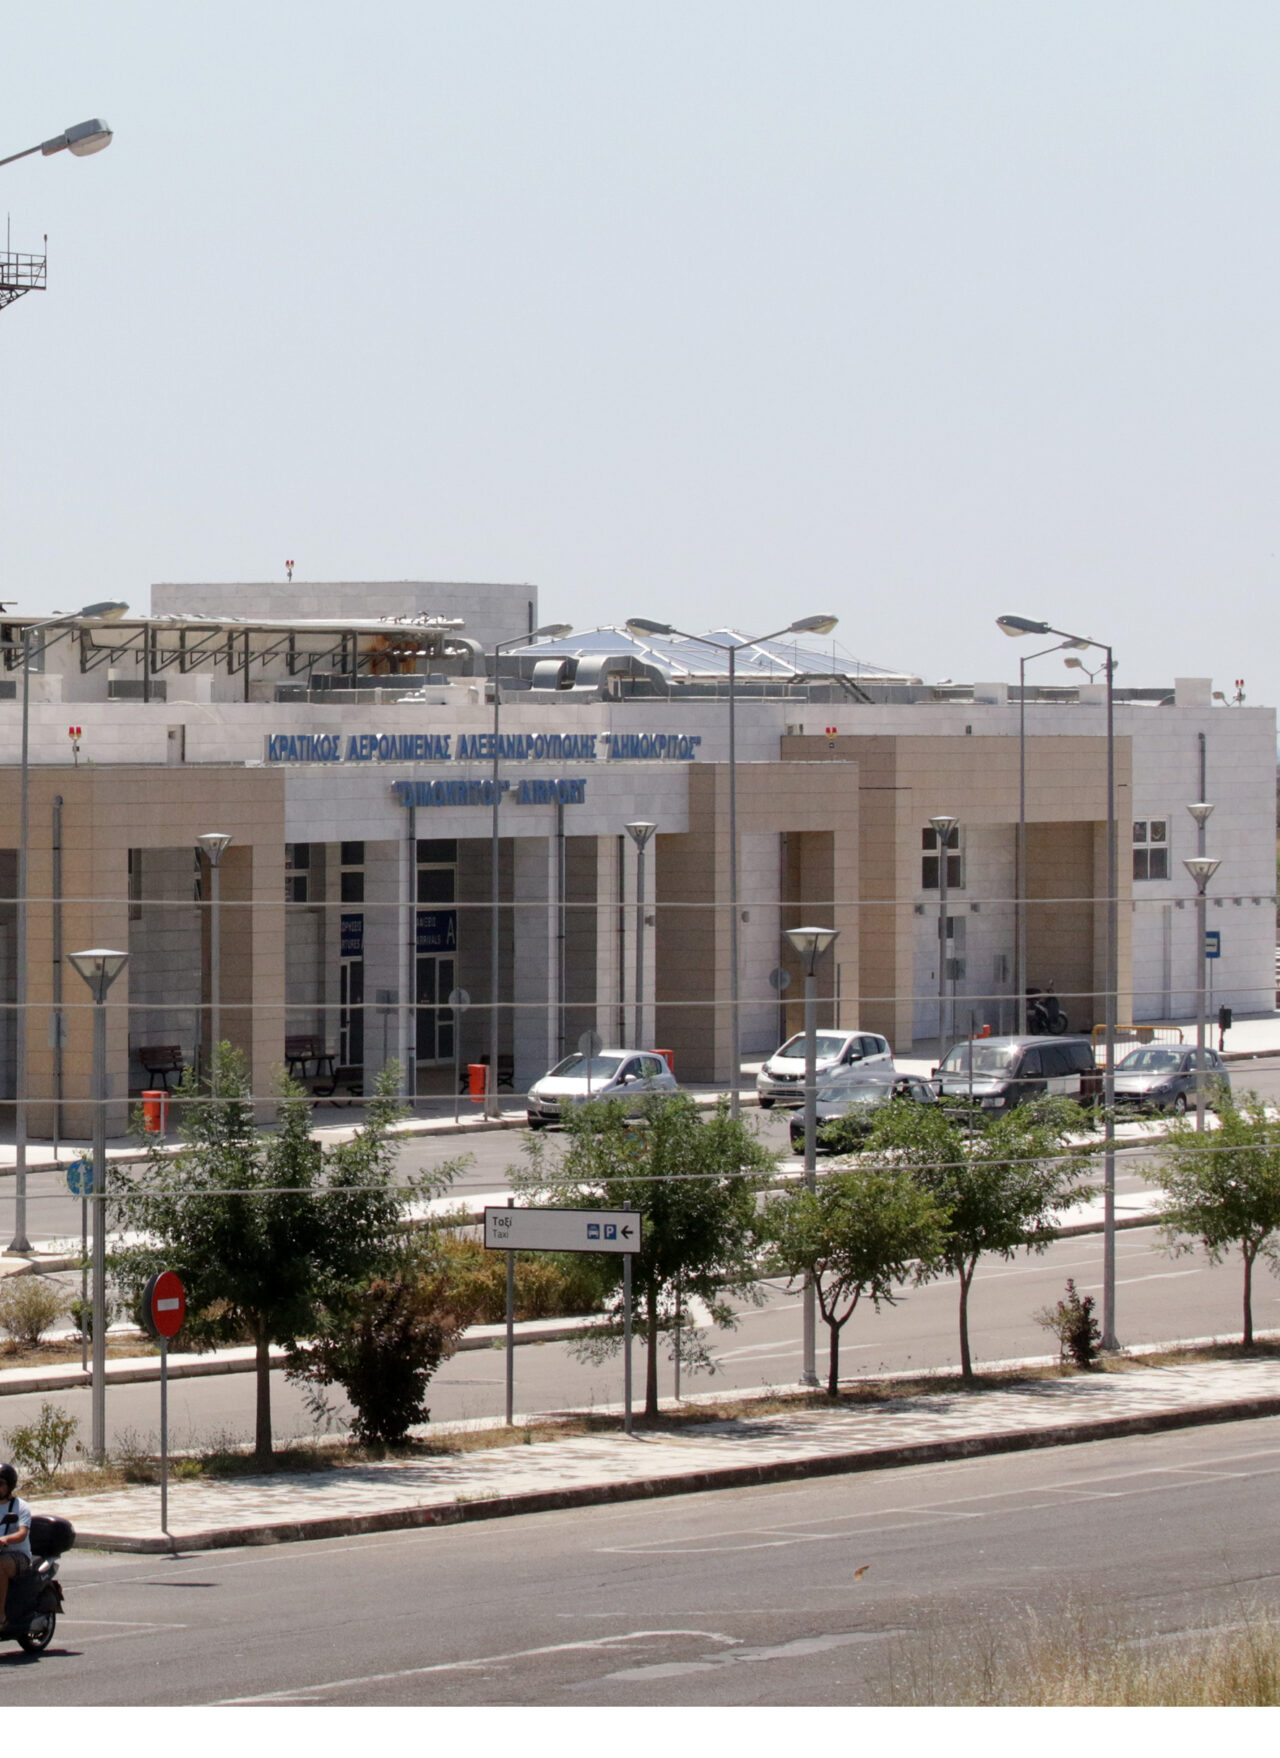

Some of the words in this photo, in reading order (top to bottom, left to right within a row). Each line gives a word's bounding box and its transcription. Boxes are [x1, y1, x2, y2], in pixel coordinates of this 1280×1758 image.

[266, 734, 341, 761] ΚΡΑΤΙΚΟΣ
[346, 734, 452, 760] ΑΕΡΟΛΙΜΕΝΑΣ
[517, 779, 587, 805] AIRPORT
